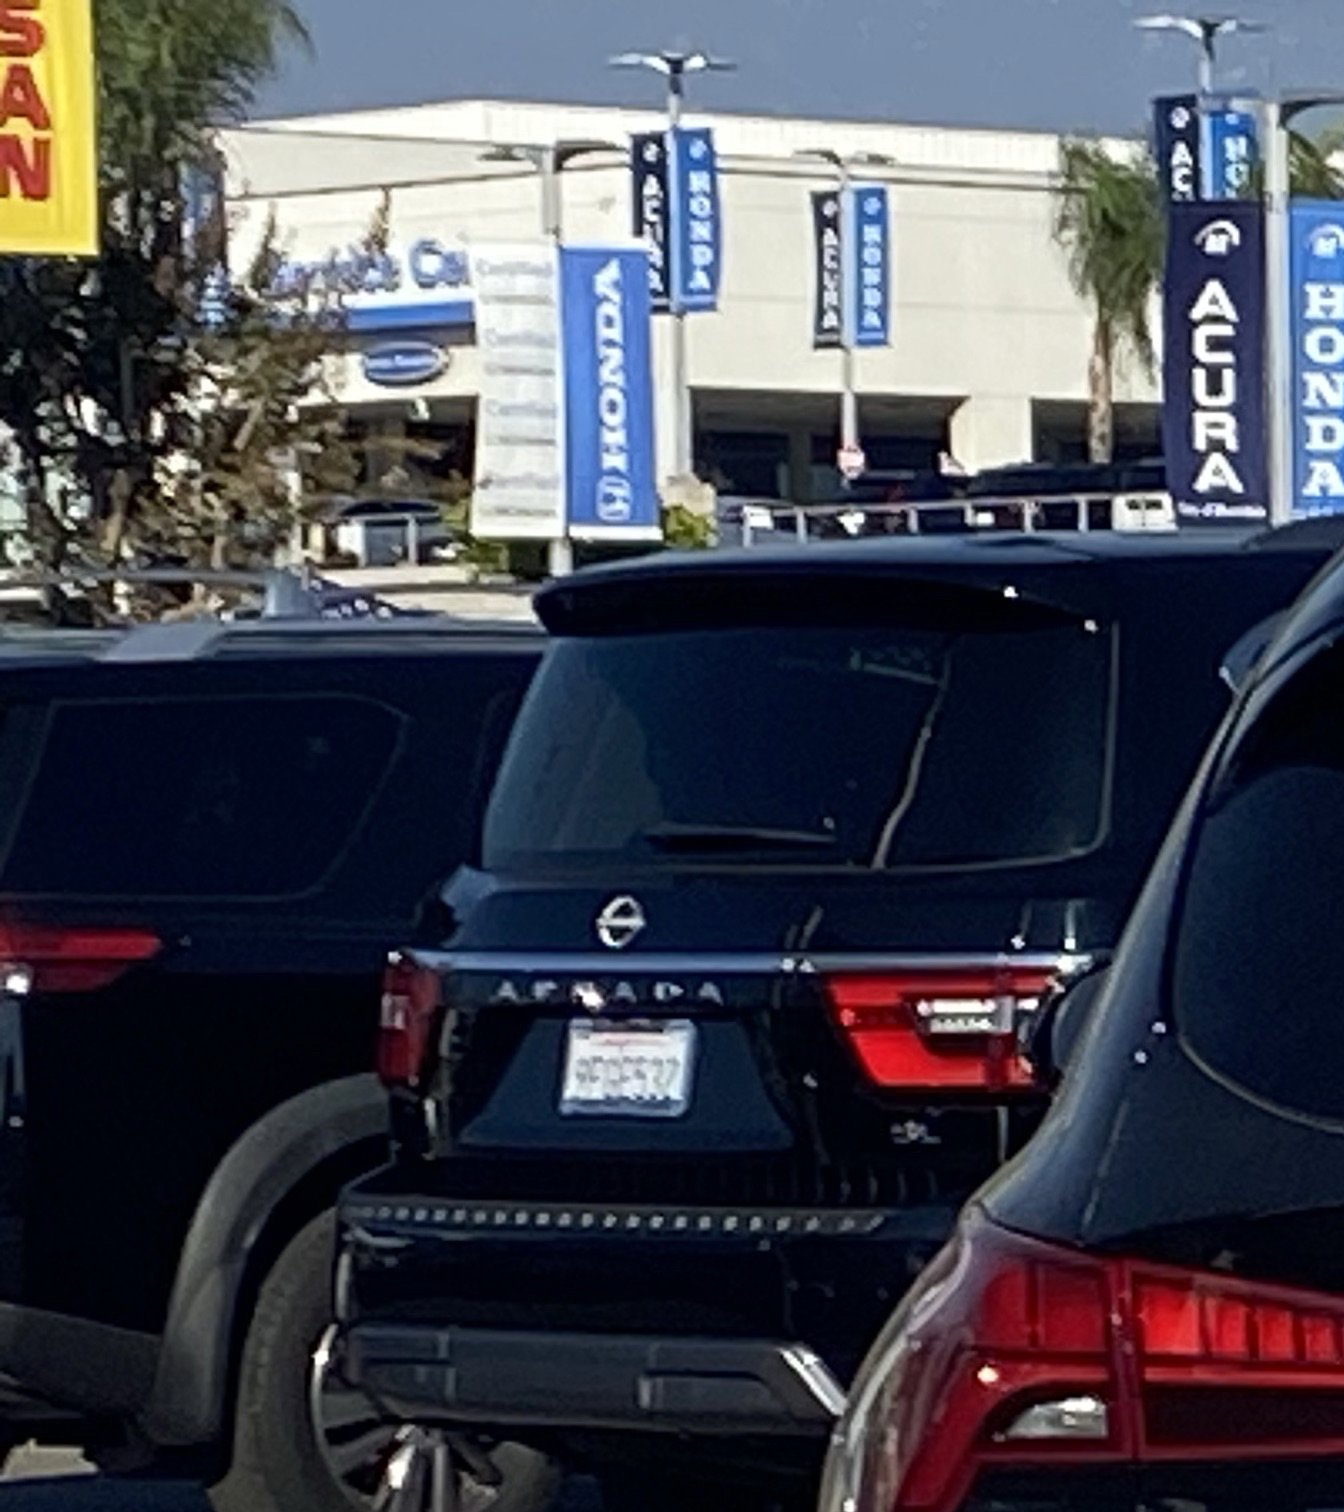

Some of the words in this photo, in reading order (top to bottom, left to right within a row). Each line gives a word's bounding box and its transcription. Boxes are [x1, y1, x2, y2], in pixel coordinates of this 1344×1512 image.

[688, 171, 714, 290] HONDA
[593, 257, 628, 475] HONDA
[1189, 278, 1245, 494] ACURA
